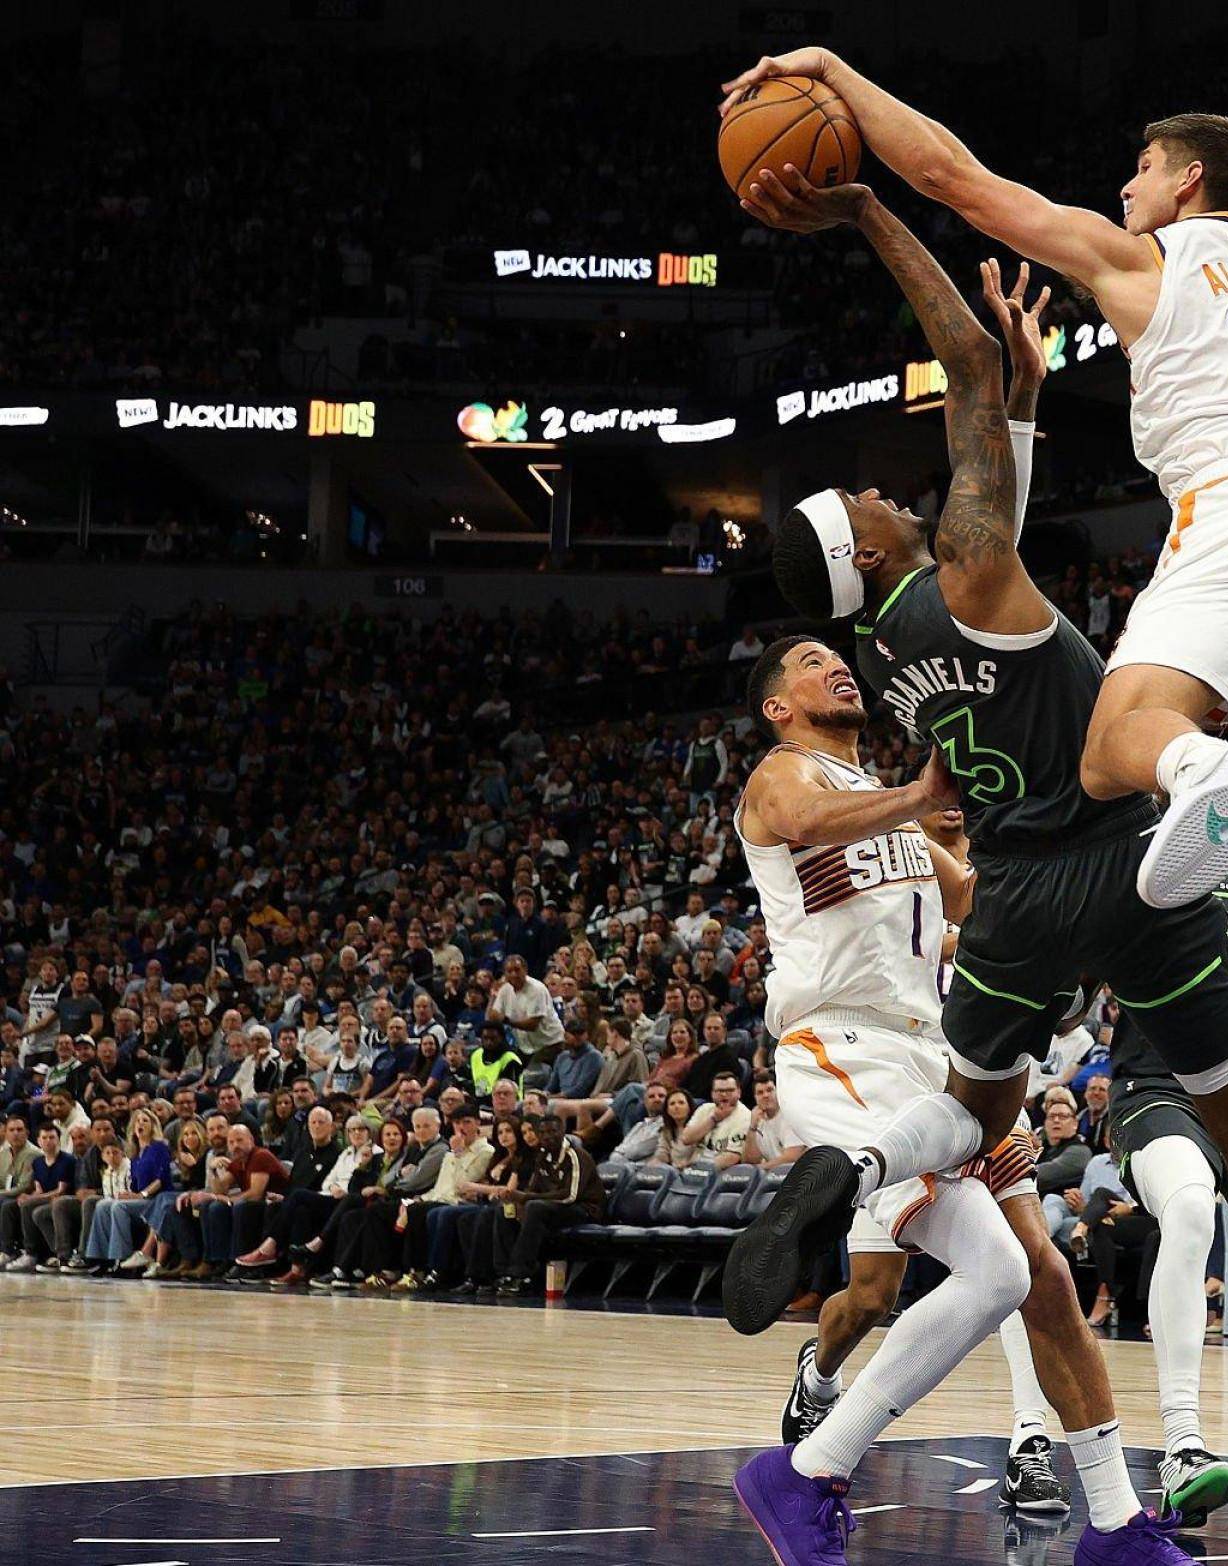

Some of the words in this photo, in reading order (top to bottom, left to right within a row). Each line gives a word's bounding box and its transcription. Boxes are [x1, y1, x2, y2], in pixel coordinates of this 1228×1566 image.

[658, 253, 717, 286] DUOS
[1074, 323, 1097, 361] 2
[308, 400, 375, 437] DUOS
[540, 407, 567, 440] 2
[393, 578, 426, 595] 106
[931, 706, 1025, 804] 3
[844, 829, 936, 890] SUNS
[912, 890, 926, 960] 1
